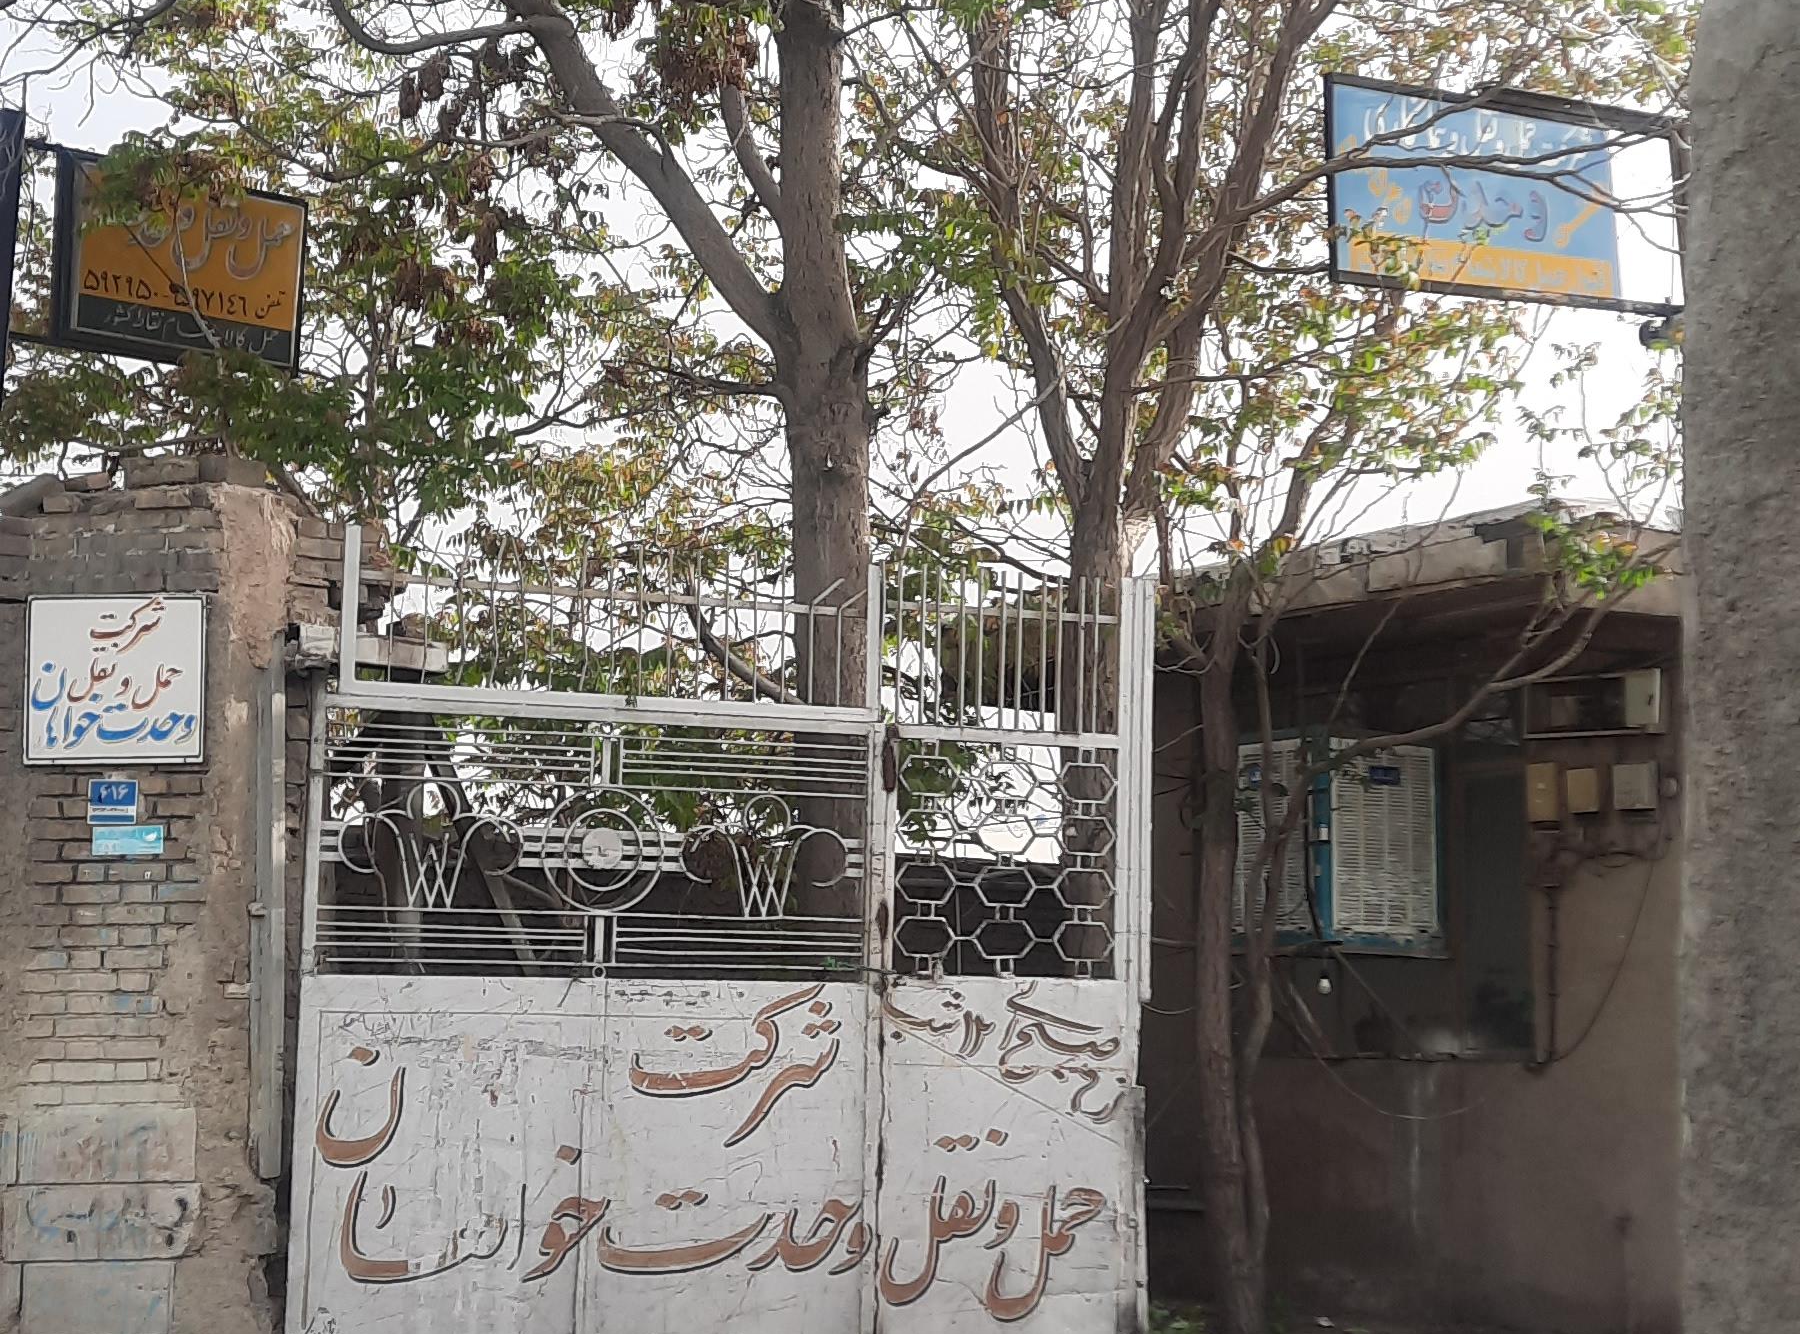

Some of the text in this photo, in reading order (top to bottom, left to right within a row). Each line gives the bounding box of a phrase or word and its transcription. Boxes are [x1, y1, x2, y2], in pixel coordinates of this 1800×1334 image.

[90, 597, 166, 655] شرکت
[31, 662, 198, 750] وحدت خواهان
[67, 641, 183, 710] حمل و نقل
[629, 984, 842, 1148] شرکت
[598, 1189, 872, 1276] وحدت
[878, 1126, 1010, 1307] نقل
[984, 1184, 1107, 1323] حمل
